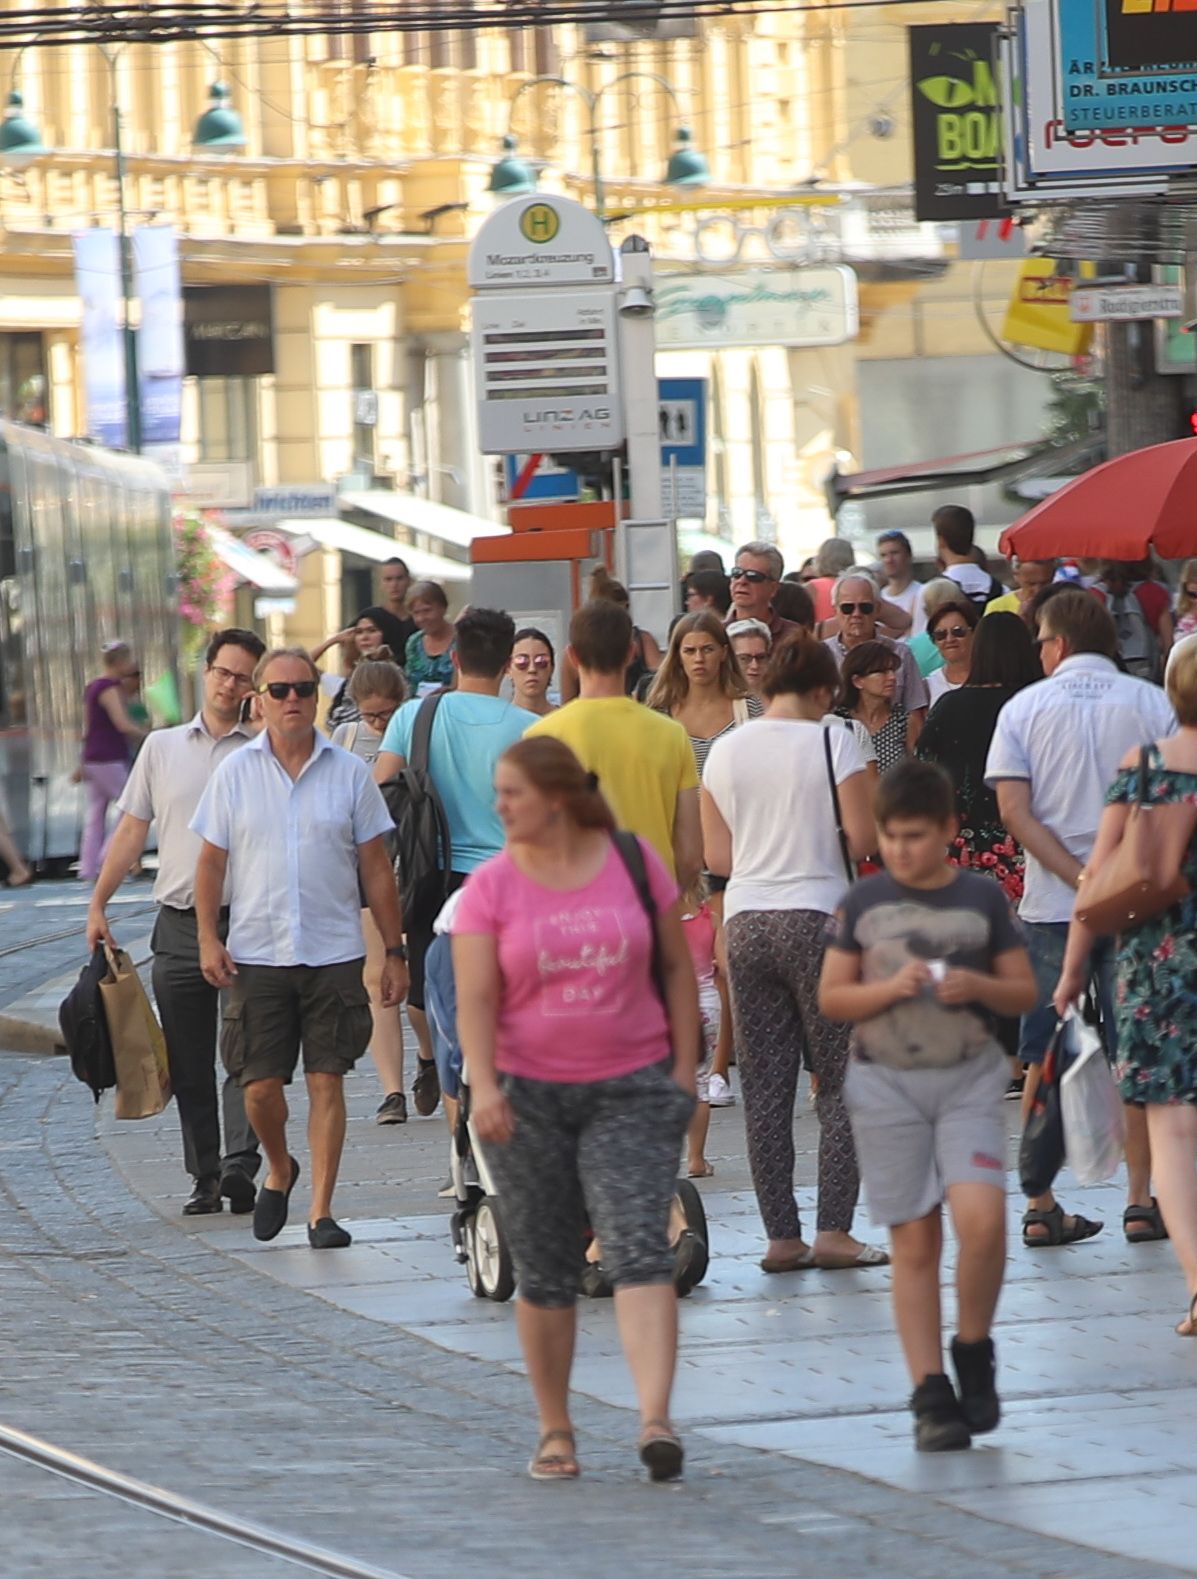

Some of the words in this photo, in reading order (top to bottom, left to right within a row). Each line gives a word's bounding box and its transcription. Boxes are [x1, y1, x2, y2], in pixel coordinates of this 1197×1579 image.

[1069, 83, 1099, 98] DR.
[486, 252, 595, 265] Mozartkreuzung
[578, 407, 610, 420] AG
[561, 984, 606, 1004] DAY
